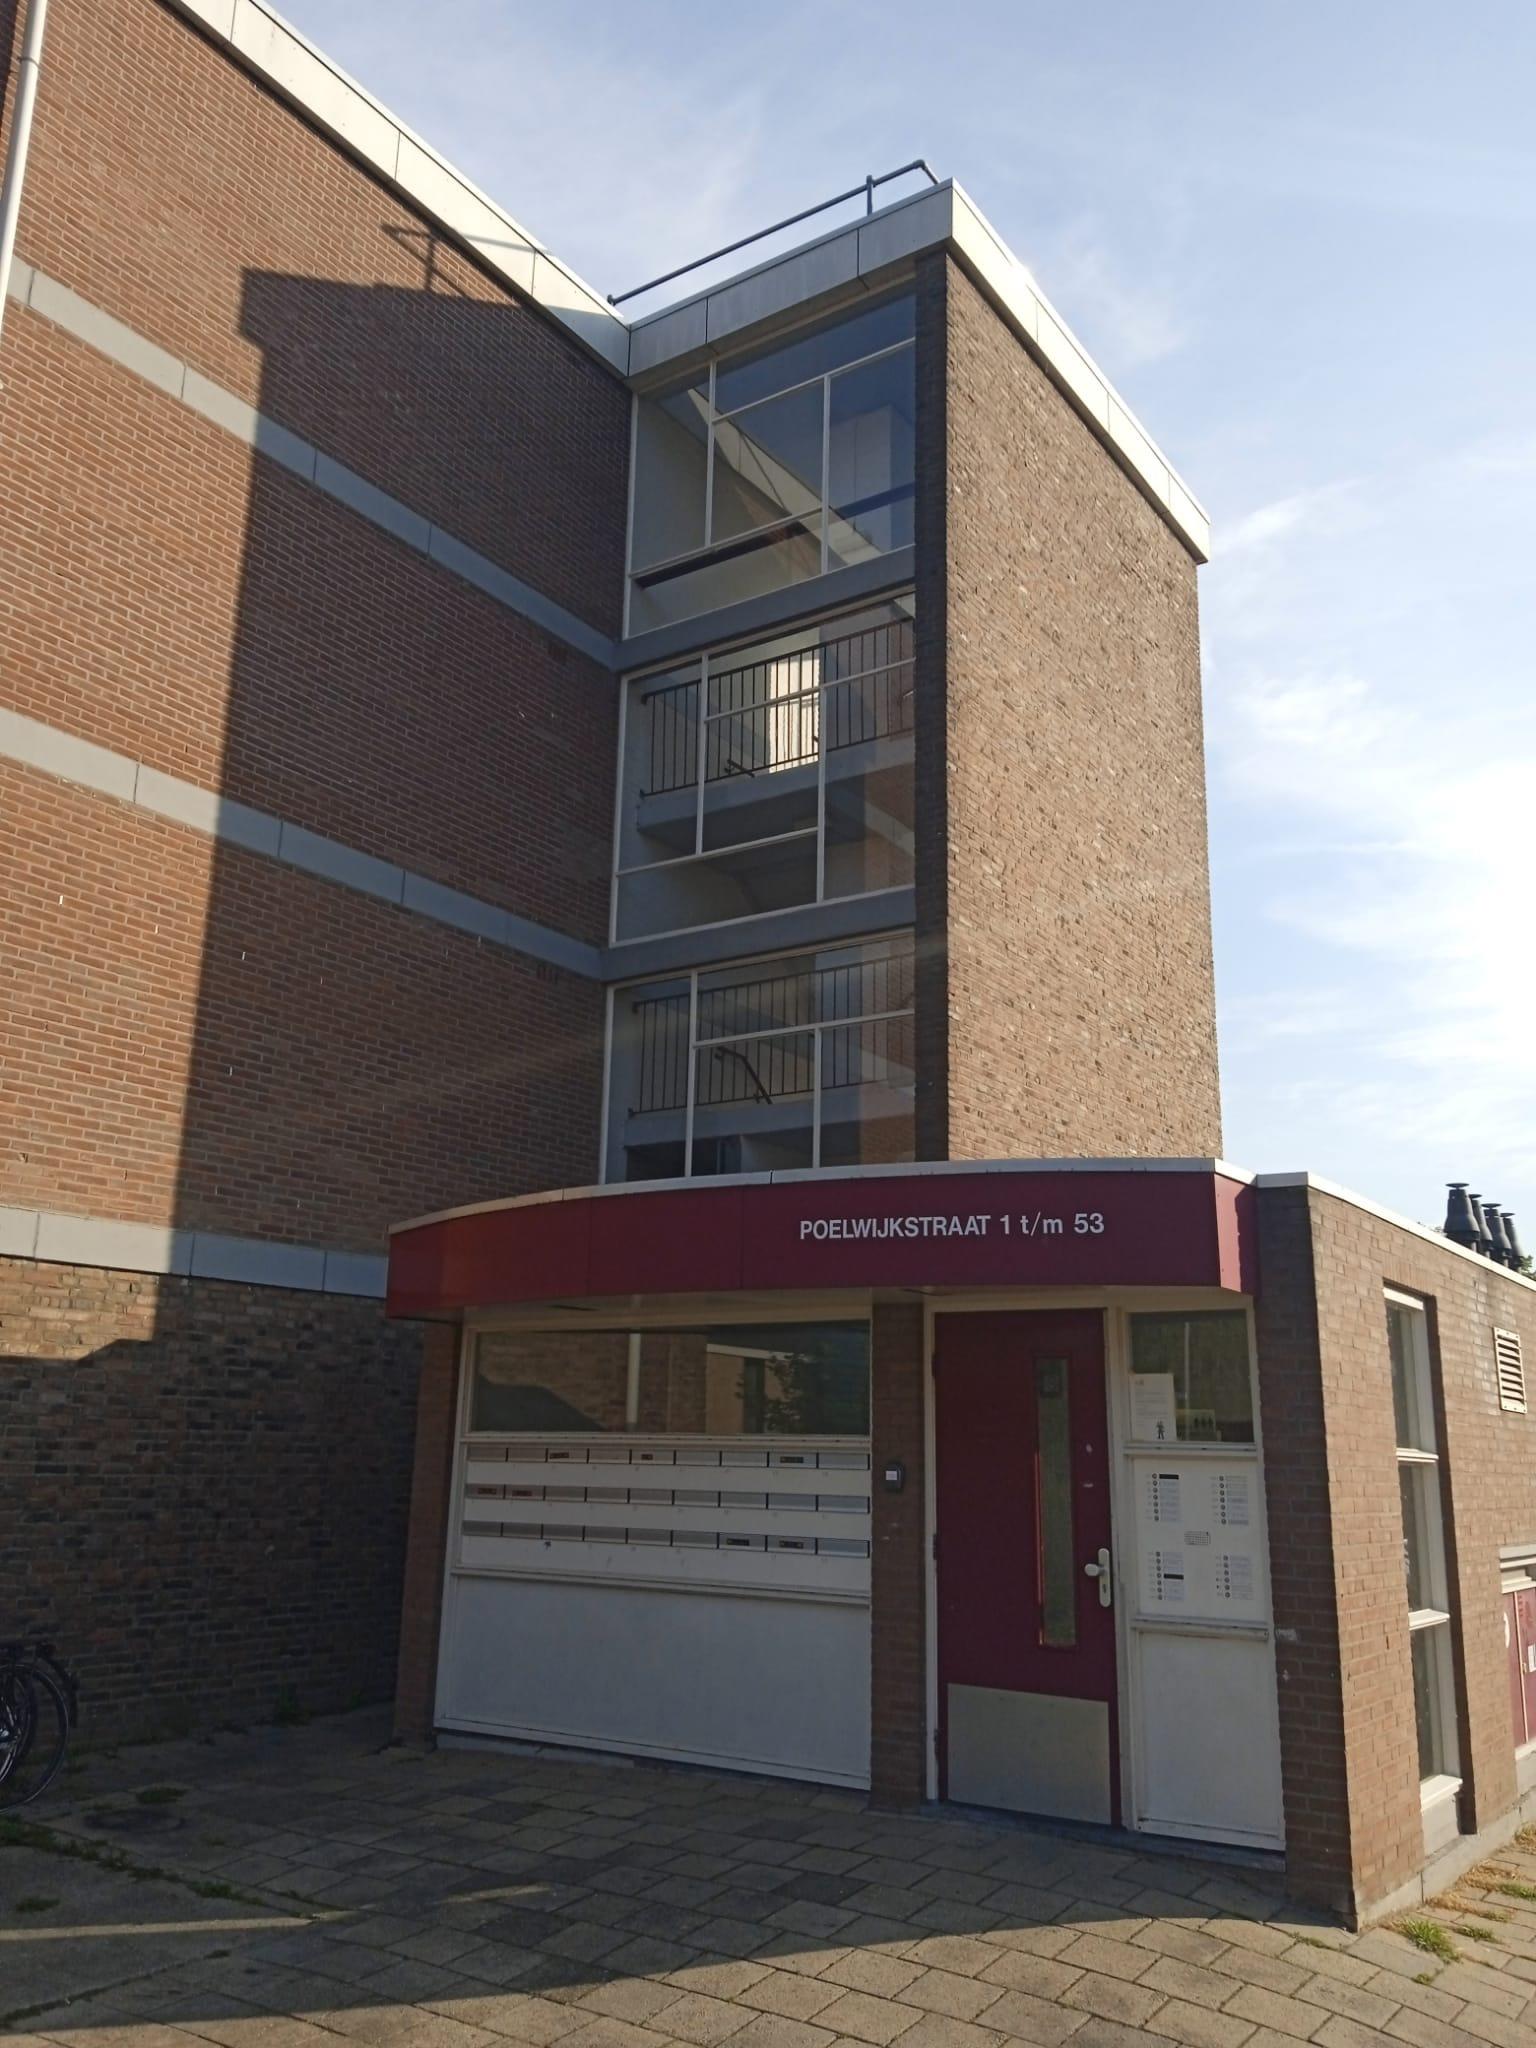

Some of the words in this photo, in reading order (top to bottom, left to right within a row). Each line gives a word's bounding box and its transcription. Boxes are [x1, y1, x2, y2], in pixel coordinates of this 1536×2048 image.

[799, 1214, 991, 1240] POELWIJKSTRAAT
[1000, 1214, 1010, 1234] 1
[1020, 1211, 1064, 1236] t/m
[1073, 1212, 1106, 1234] 53
